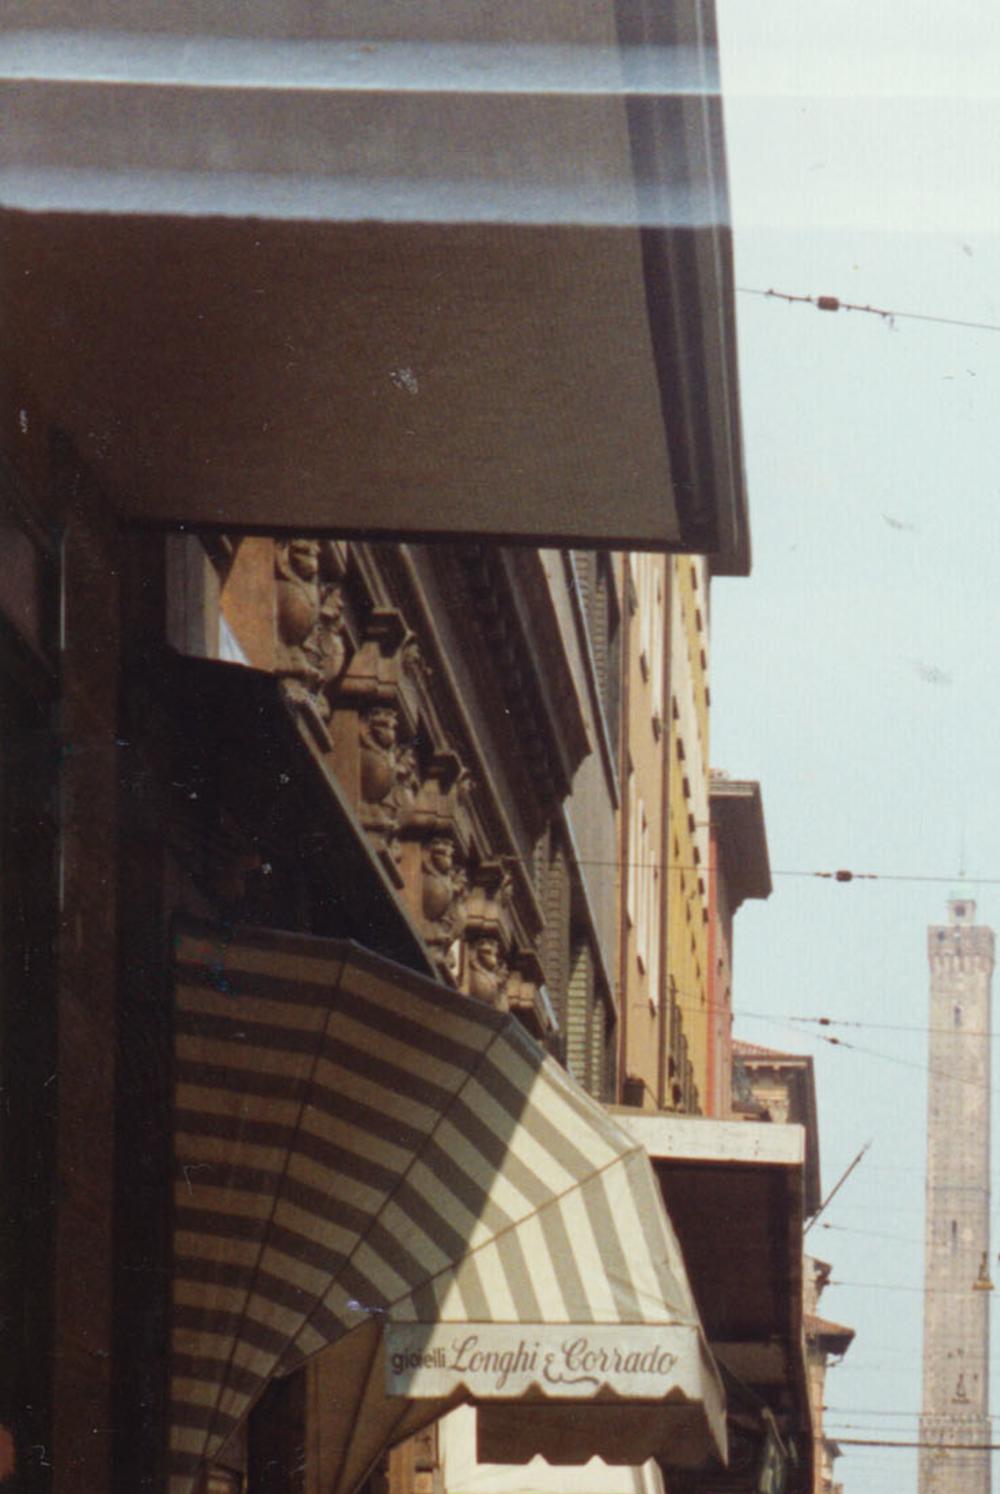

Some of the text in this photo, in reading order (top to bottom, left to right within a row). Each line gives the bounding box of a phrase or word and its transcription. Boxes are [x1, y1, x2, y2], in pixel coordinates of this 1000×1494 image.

[391, 1346, 446, 1376] gioielli
[448, 1335, 541, 1390] Longhi
[561, 1337, 679, 1376] Corrado
